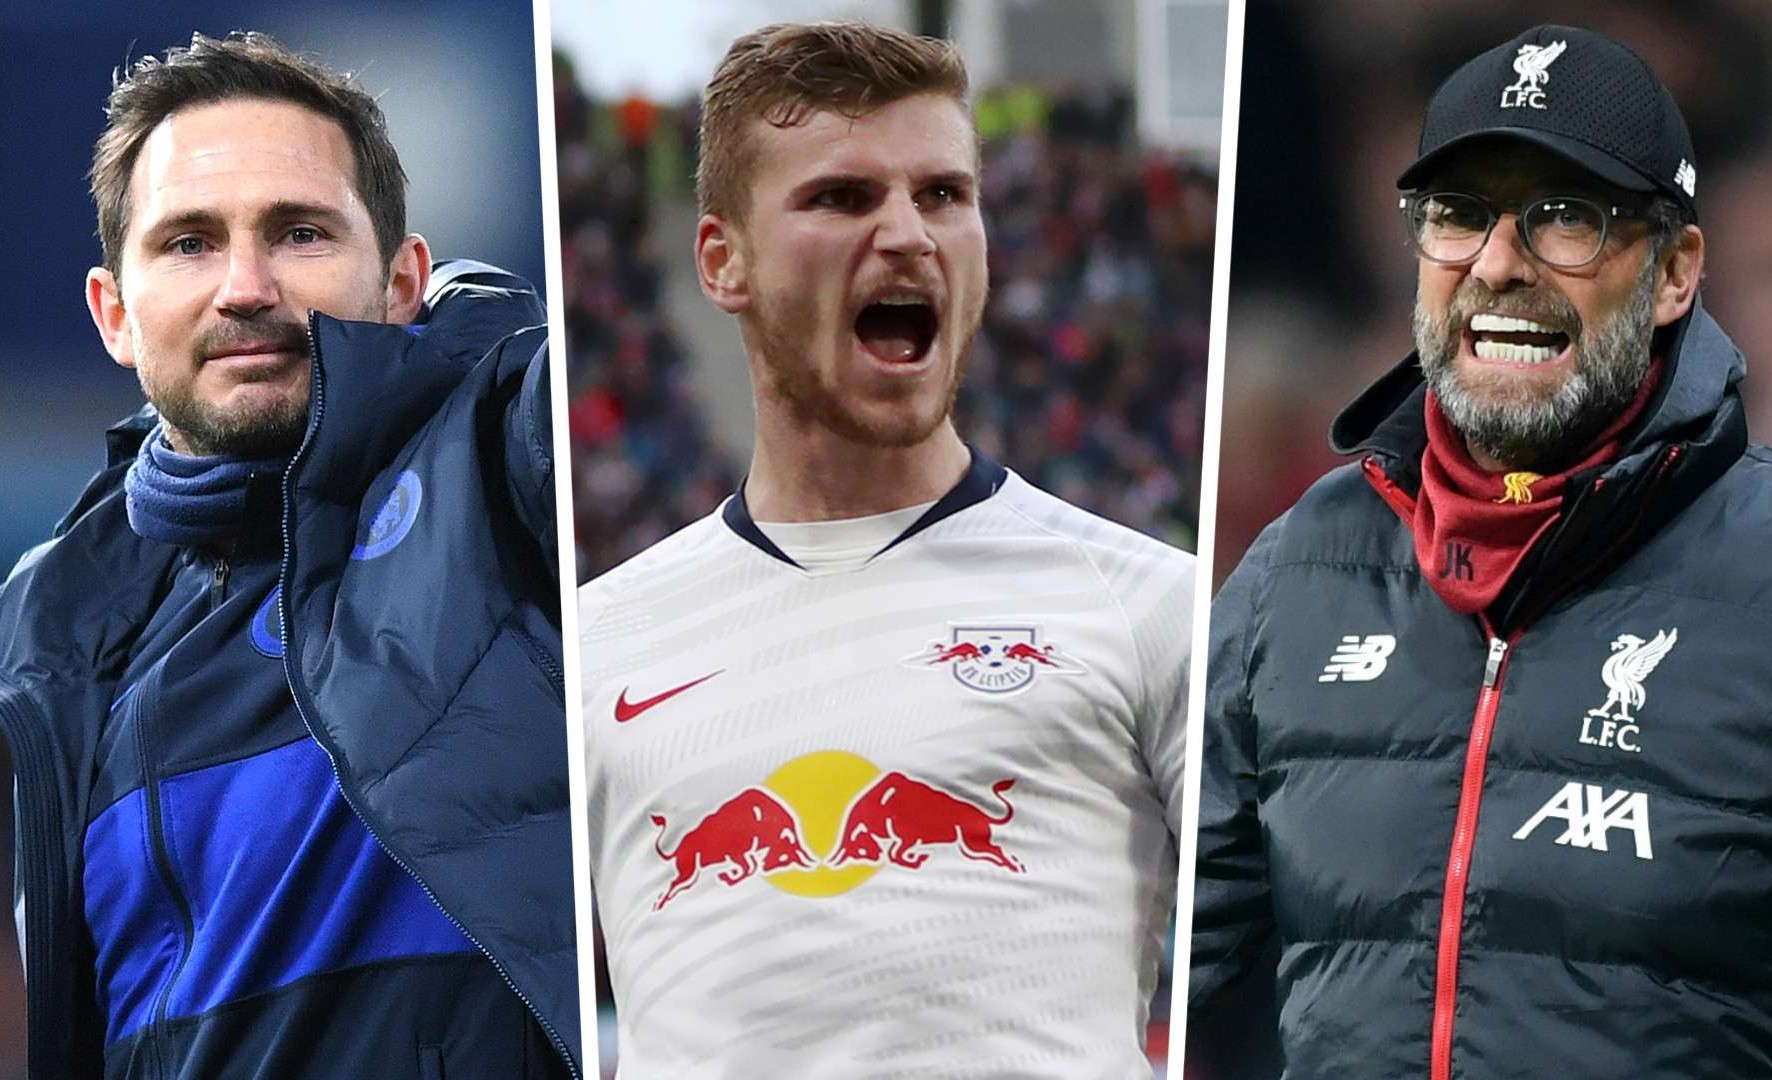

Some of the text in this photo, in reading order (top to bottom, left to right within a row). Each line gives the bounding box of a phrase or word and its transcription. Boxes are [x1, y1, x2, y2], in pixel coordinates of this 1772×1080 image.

[1439, 542, 1474, 582] JK
[1579, 717, 1641, 752] L.F.C.
[1512, 782, 1654, 860] AXA
